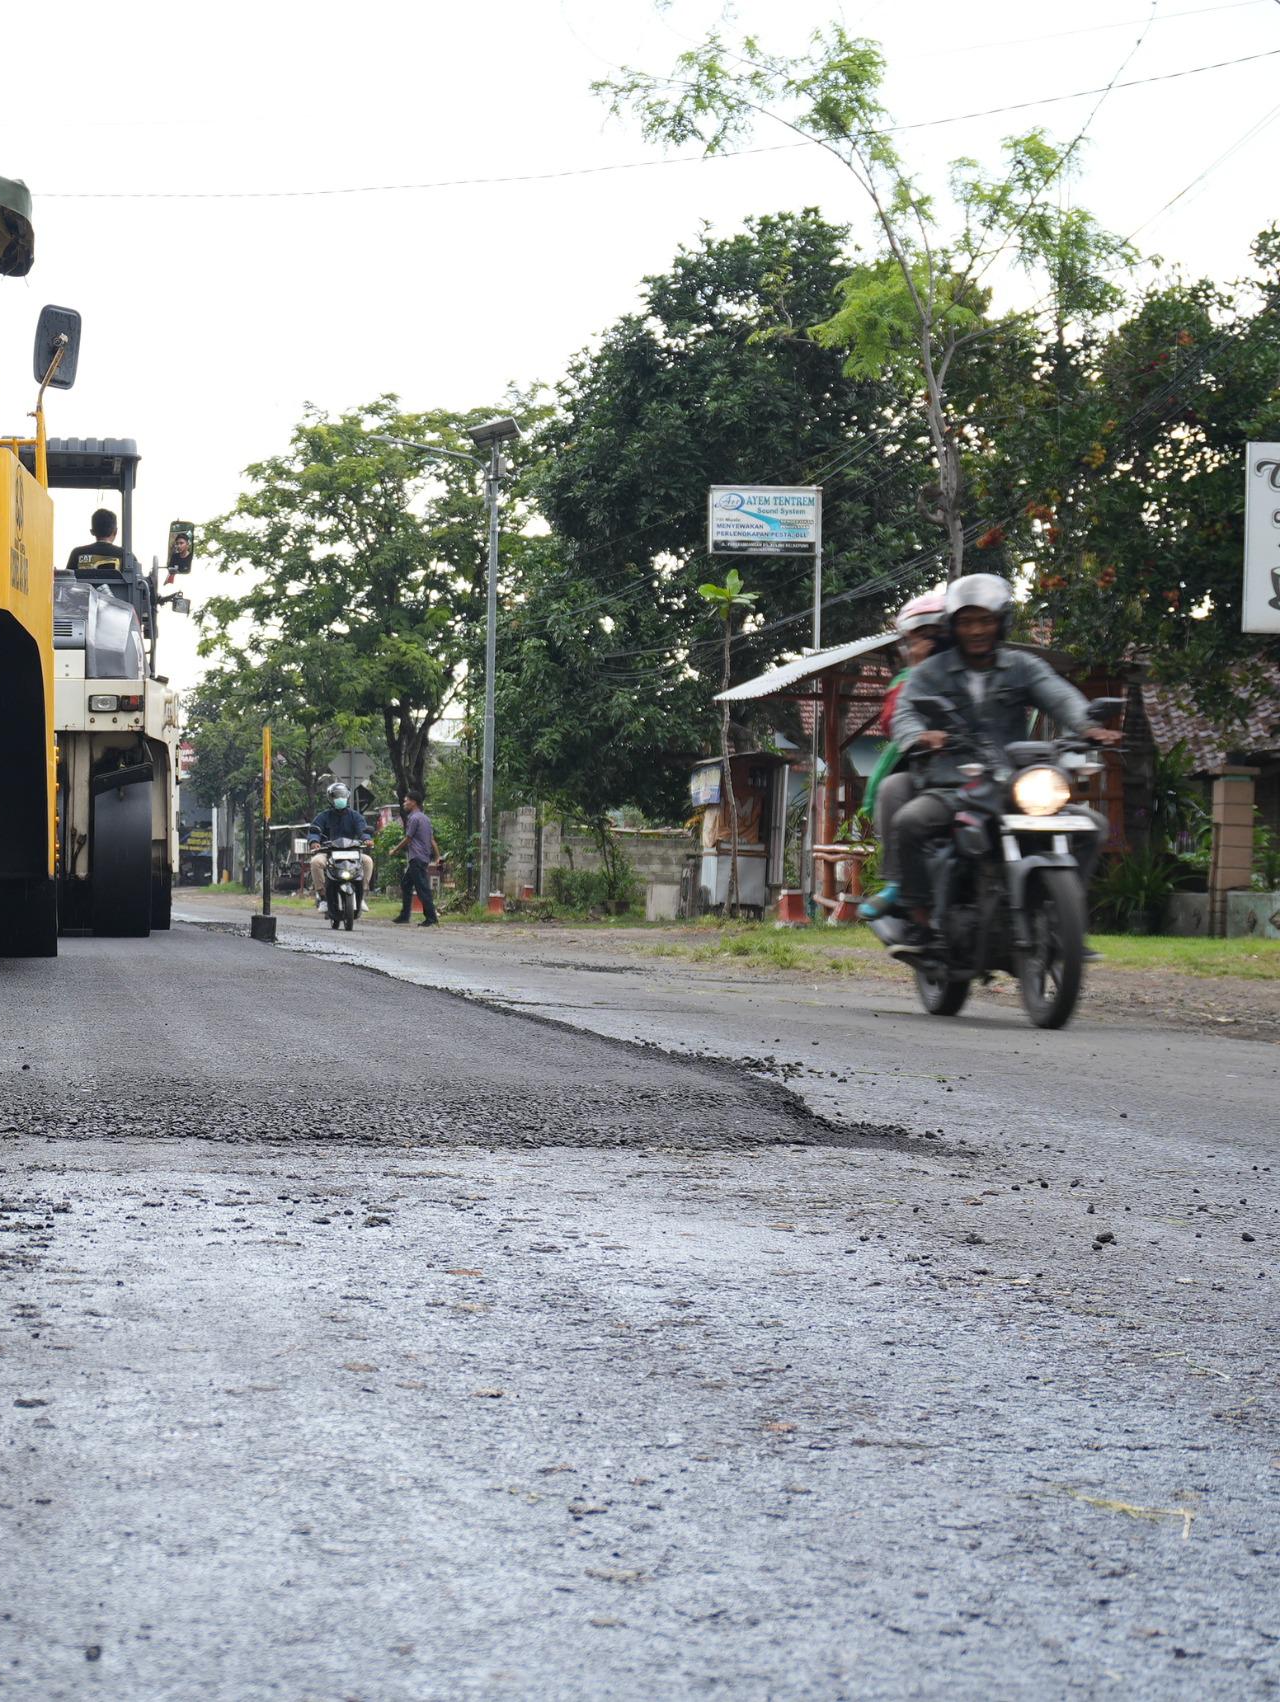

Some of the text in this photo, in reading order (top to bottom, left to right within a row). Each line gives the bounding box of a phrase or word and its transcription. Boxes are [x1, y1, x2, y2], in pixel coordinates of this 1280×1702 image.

[746, 495, 771, 506] AYEM
[773, 496, 815, 507] TENTREM
[78, 554, 93, 563] CAT
